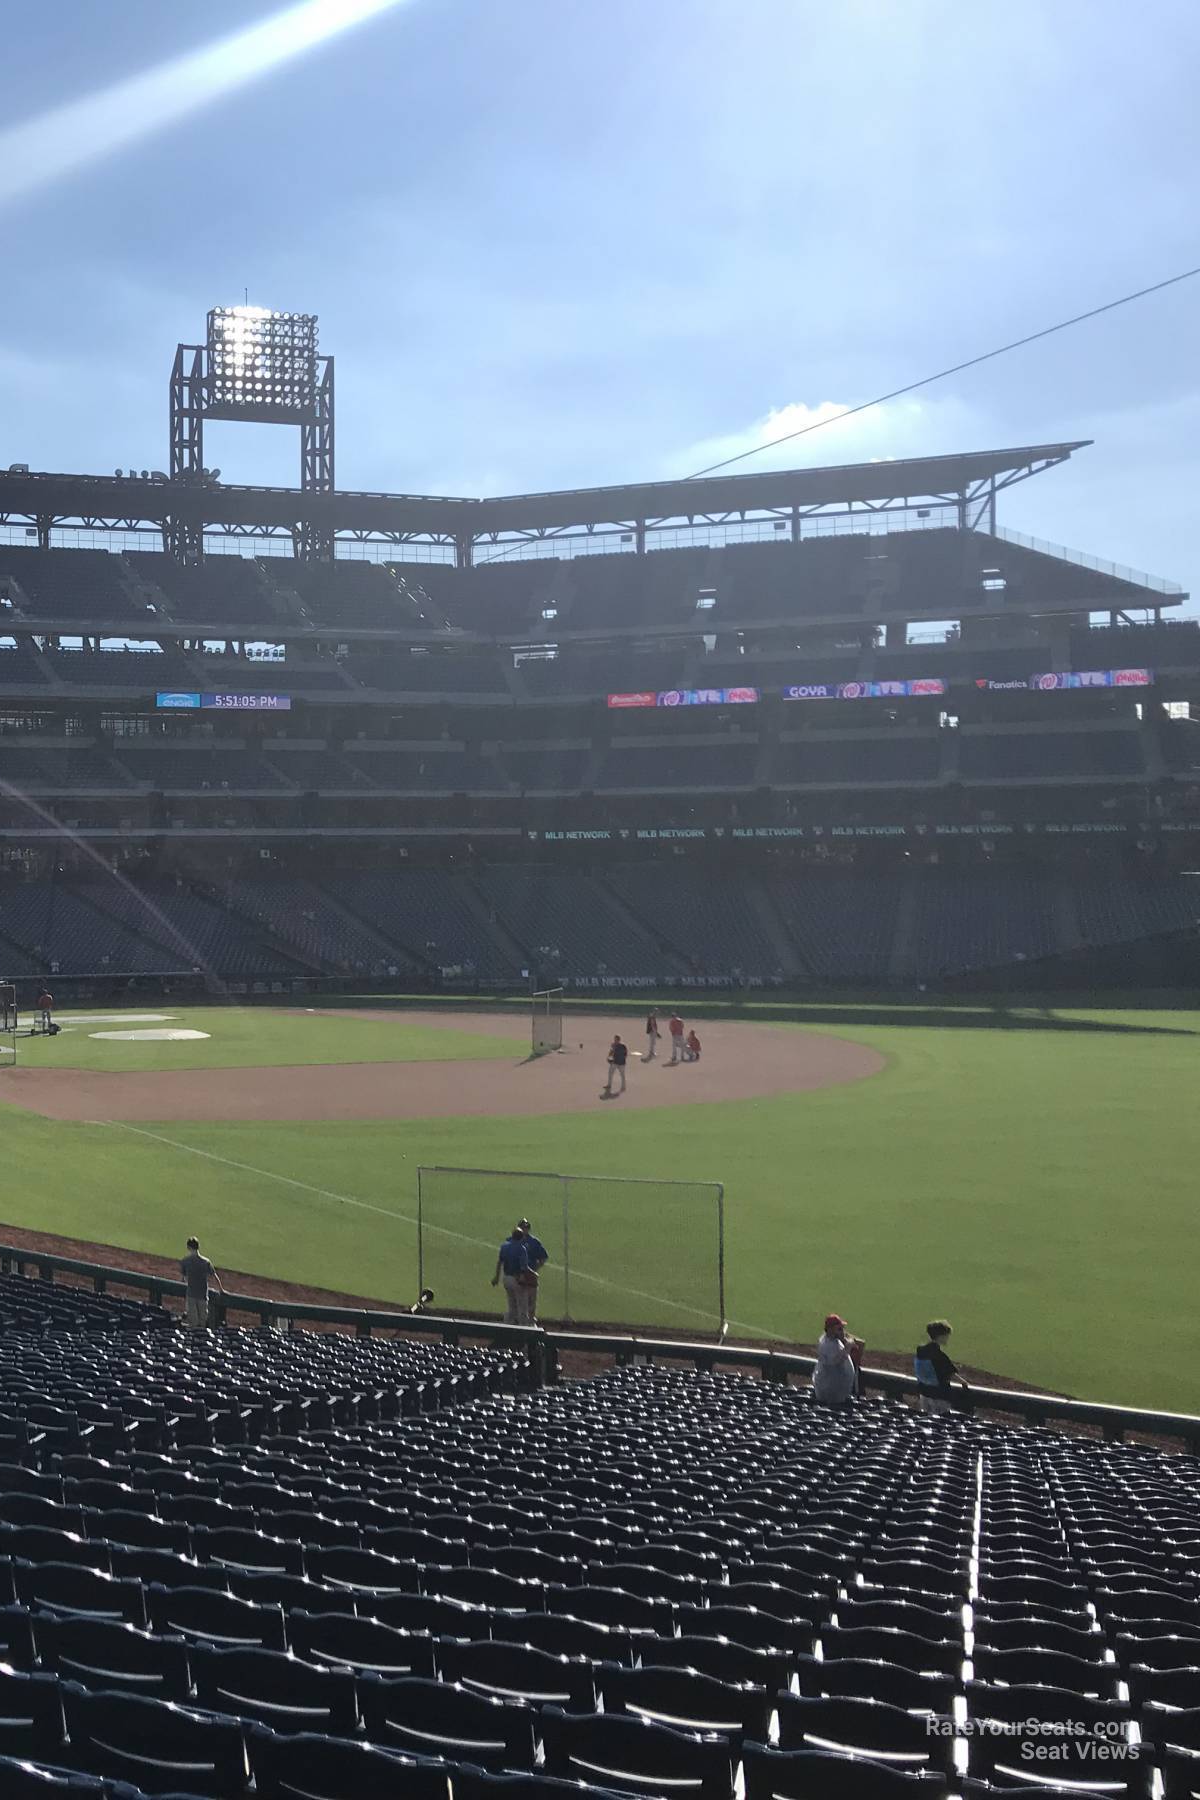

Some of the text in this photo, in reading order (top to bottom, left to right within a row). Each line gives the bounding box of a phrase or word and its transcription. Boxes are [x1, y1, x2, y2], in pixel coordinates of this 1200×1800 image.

[988, 679, 1028, 690] Fanatics
[789, 686, 827, 698] GOYA
[215, 695, 277, 707] 5:51:05 PM
[545, 831, 611, 839] MLB NETWORK
[637, 829, 705, 838] MLB NETWORK
[755, 827, 803, 836] NETWORK
[855, 826, 906, 835] NETWORK
